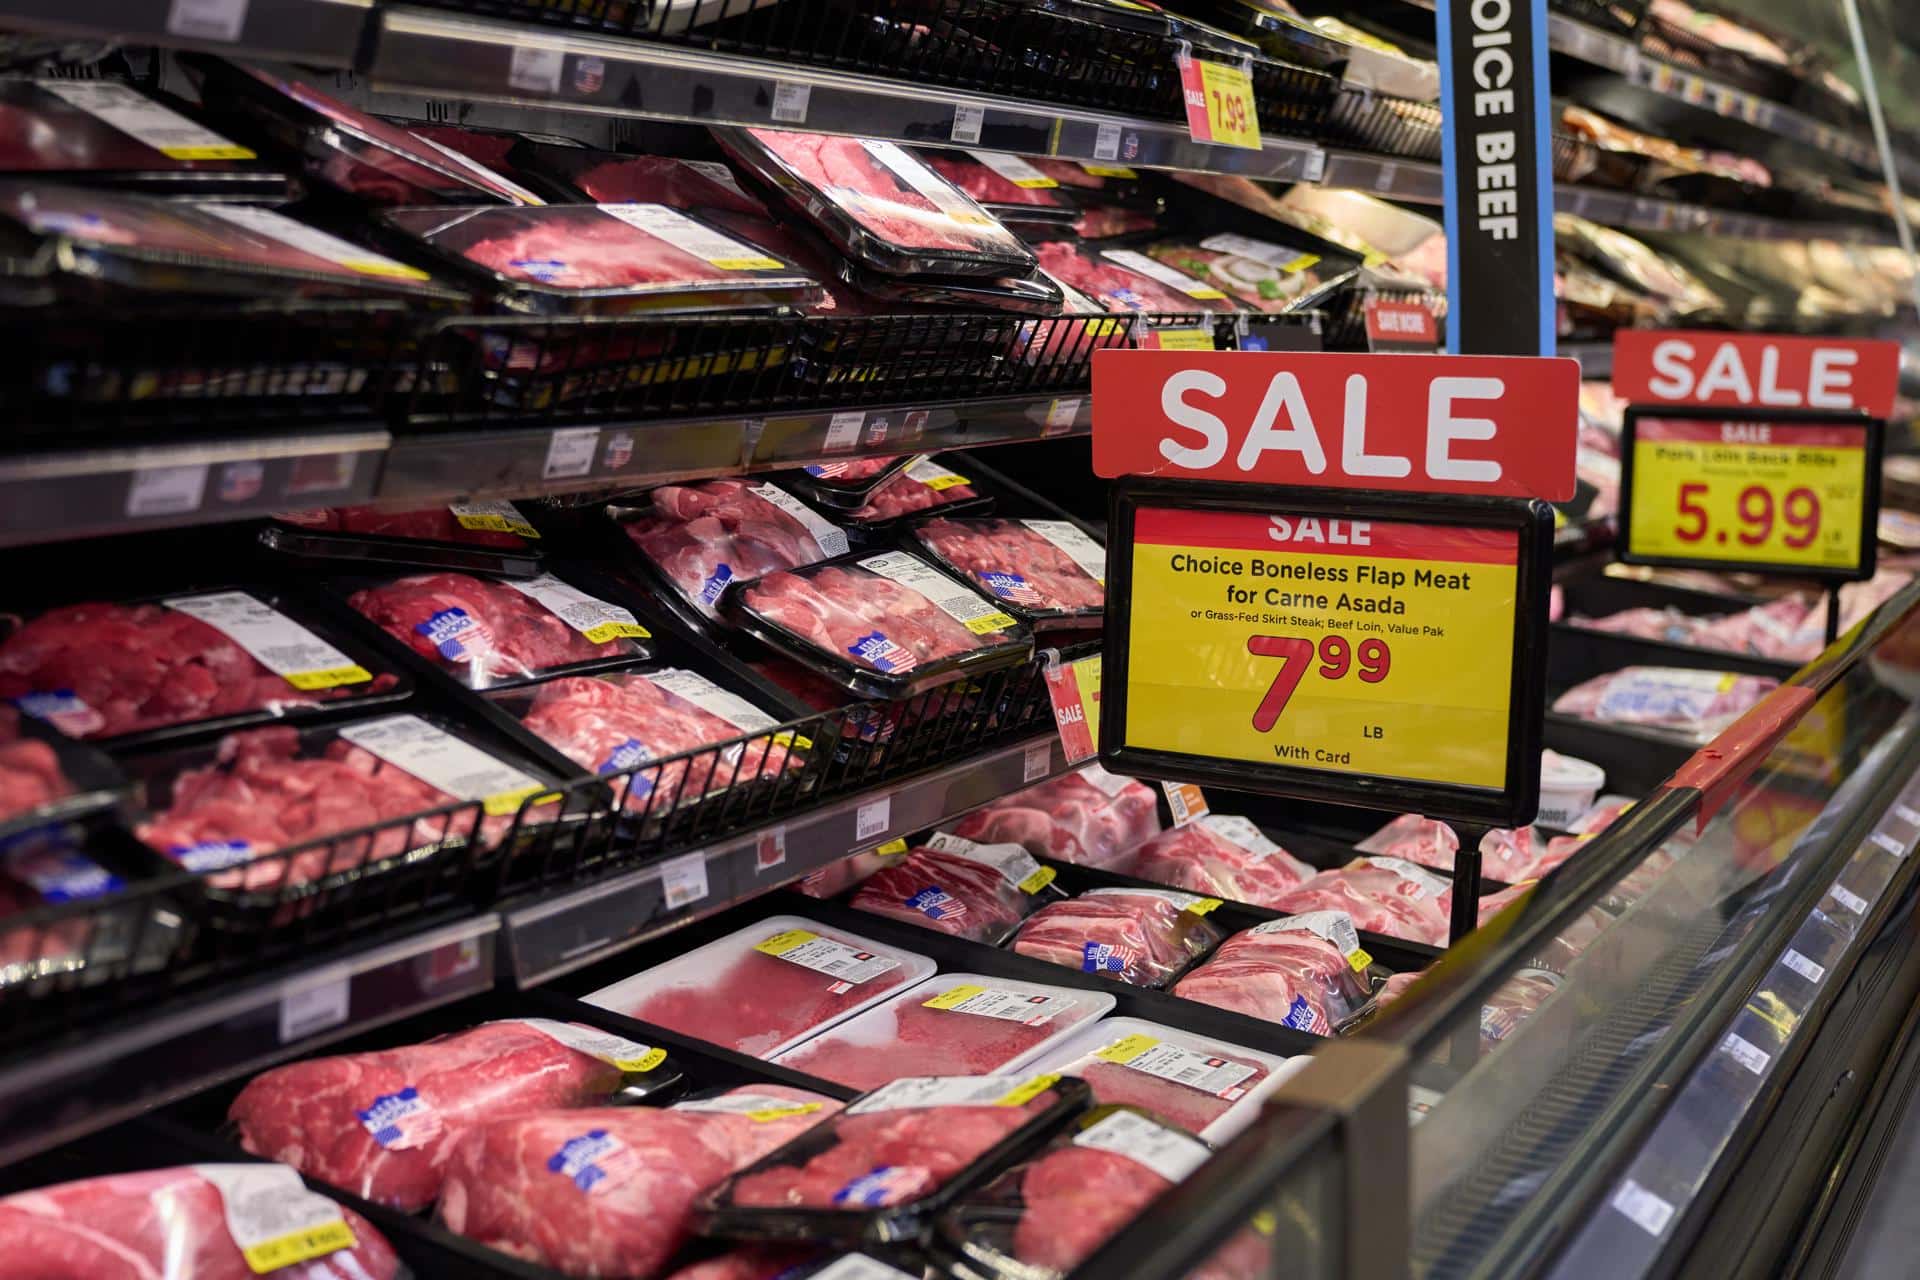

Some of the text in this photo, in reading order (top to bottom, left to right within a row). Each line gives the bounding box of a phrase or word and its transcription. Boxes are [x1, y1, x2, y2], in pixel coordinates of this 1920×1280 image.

[1186, 89, 1246, 133] SALE 7.99
[1471, 0, 1518, 241] OICE BEEF
[1648, 340, 1859, 409] SALE
[1159, 369, 1505, 482] SALE
[1720, 423, 1772, 443] SALE
[1656, 447, 1695, 461] Pork
[1268, 515, 1371, 546] SALE
[1674, 483, 1822, 550] 5.99
[1171, 554, 1471, 590] Choice Boneless Flap Meat
[1227, 585, 1405, 615] for Carne Asada
[1191, 609, 1445, 637] or Grass-Fed Skirt Steak; Beef Loin, Value Pak
[1058, 704, 1083, 725] SALE
[1363, 725, 1385, 739] LB
[1274, 744, 1351, 765] With Card
[1537, 808, 1567, 822] OODS
